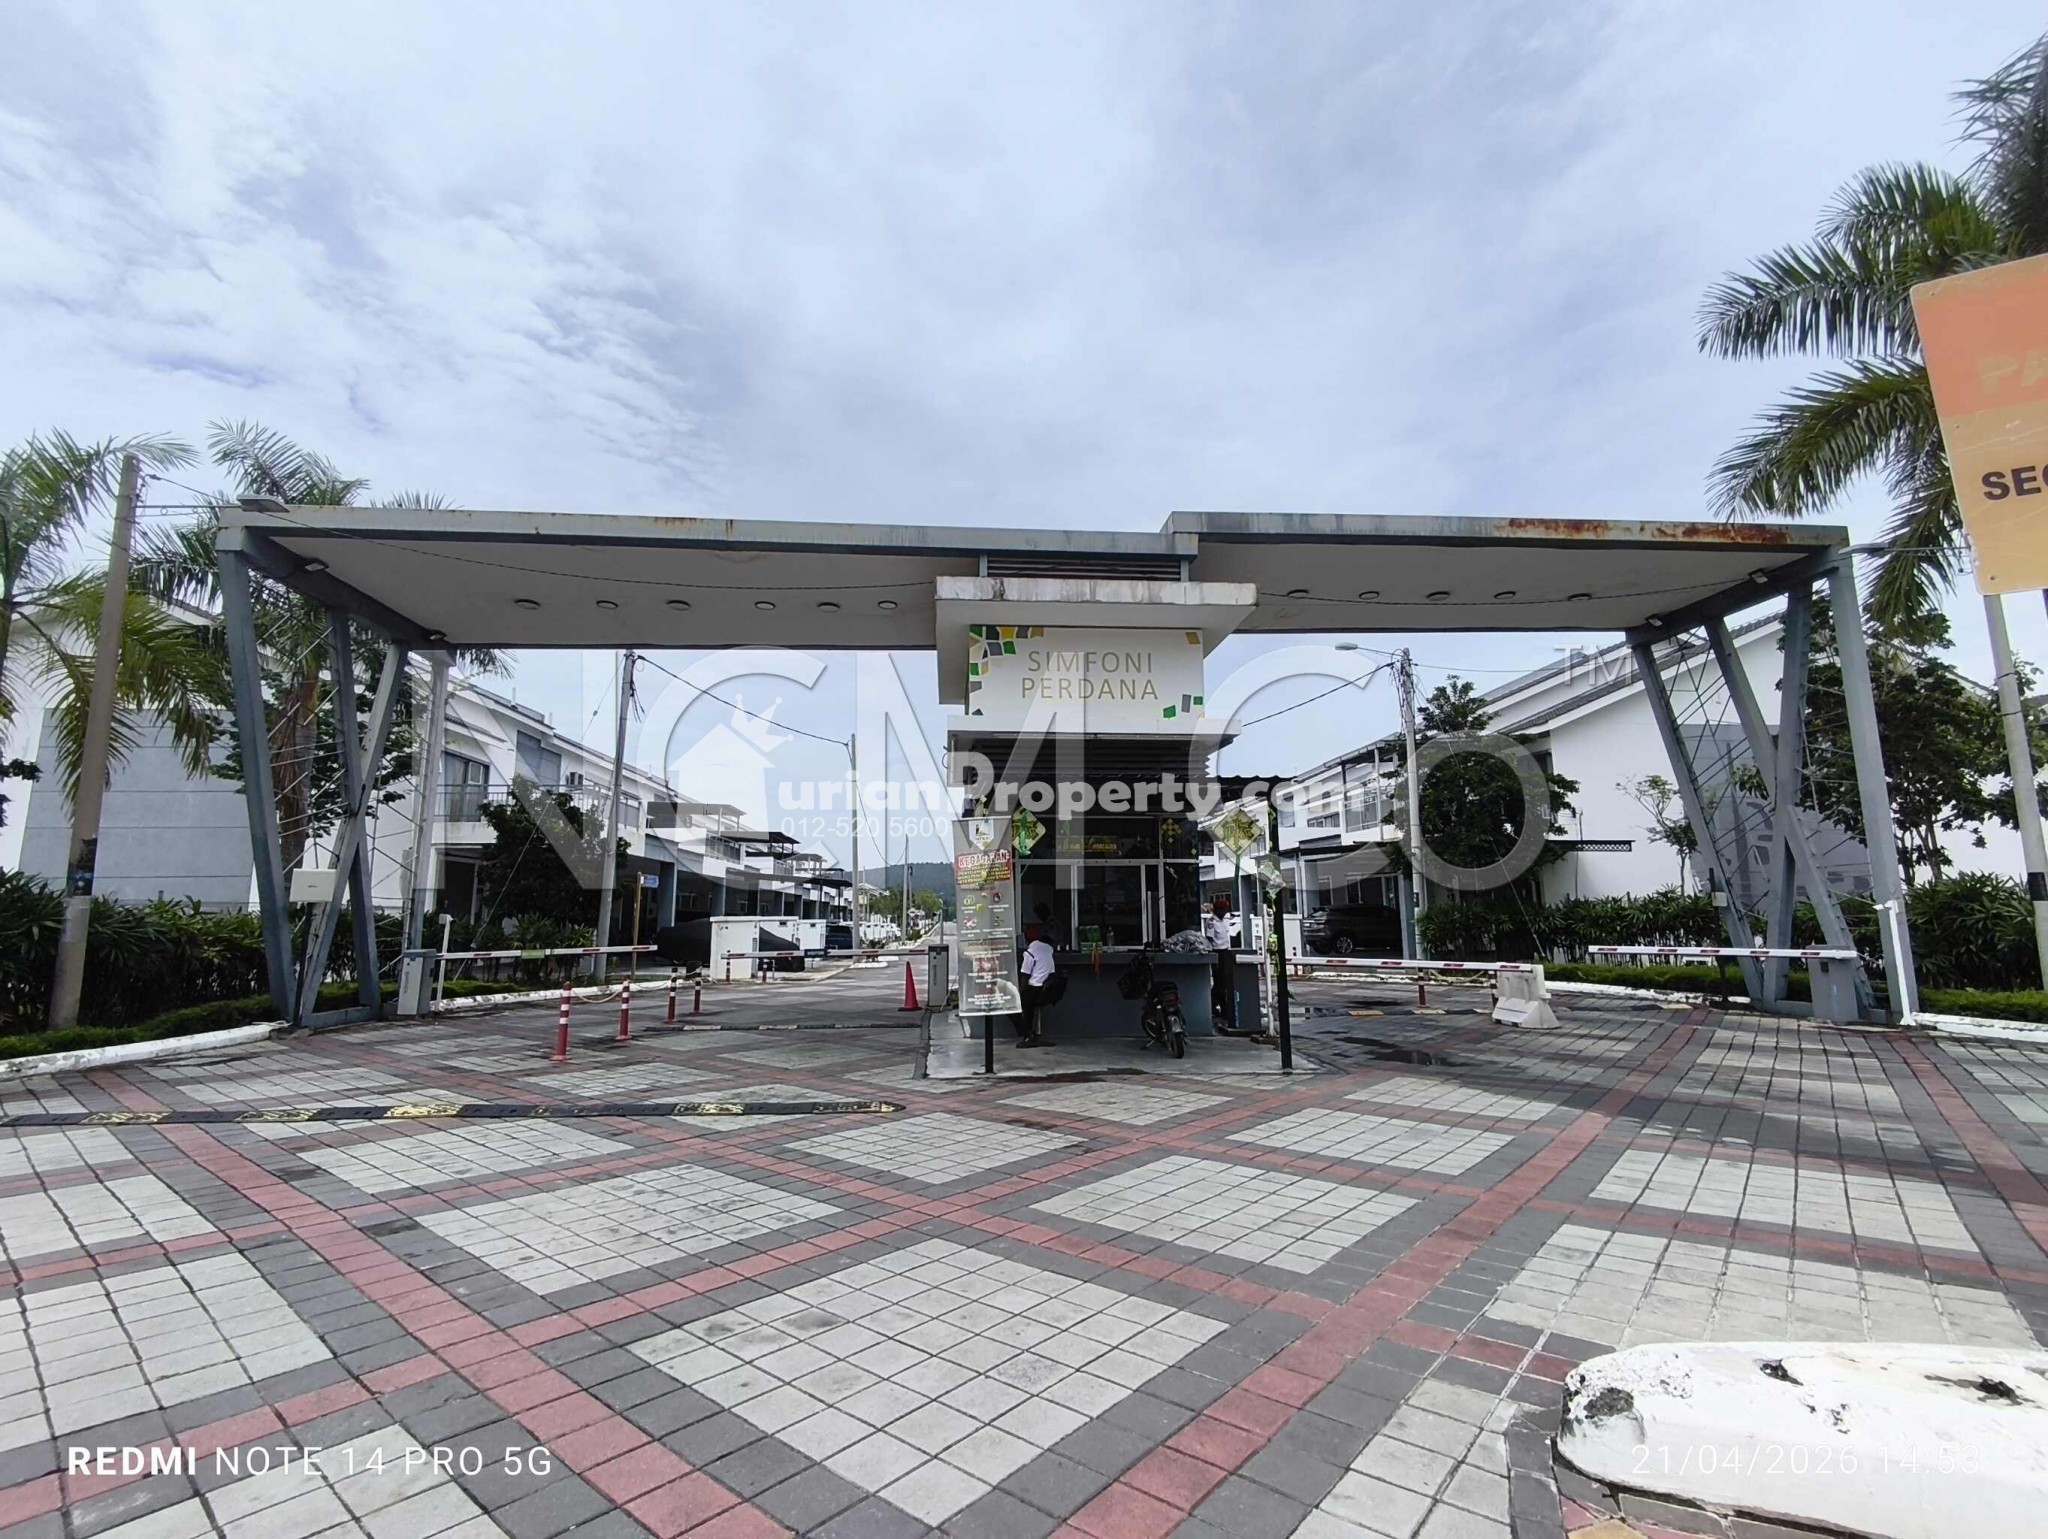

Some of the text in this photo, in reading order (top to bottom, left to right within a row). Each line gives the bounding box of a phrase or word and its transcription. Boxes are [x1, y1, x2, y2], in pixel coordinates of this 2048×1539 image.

[1982, 463, 2048, 501] SE
[1028, 650, 1153, 674] SIMFONI
[1021, 677, 1159, 701] PERDANA
